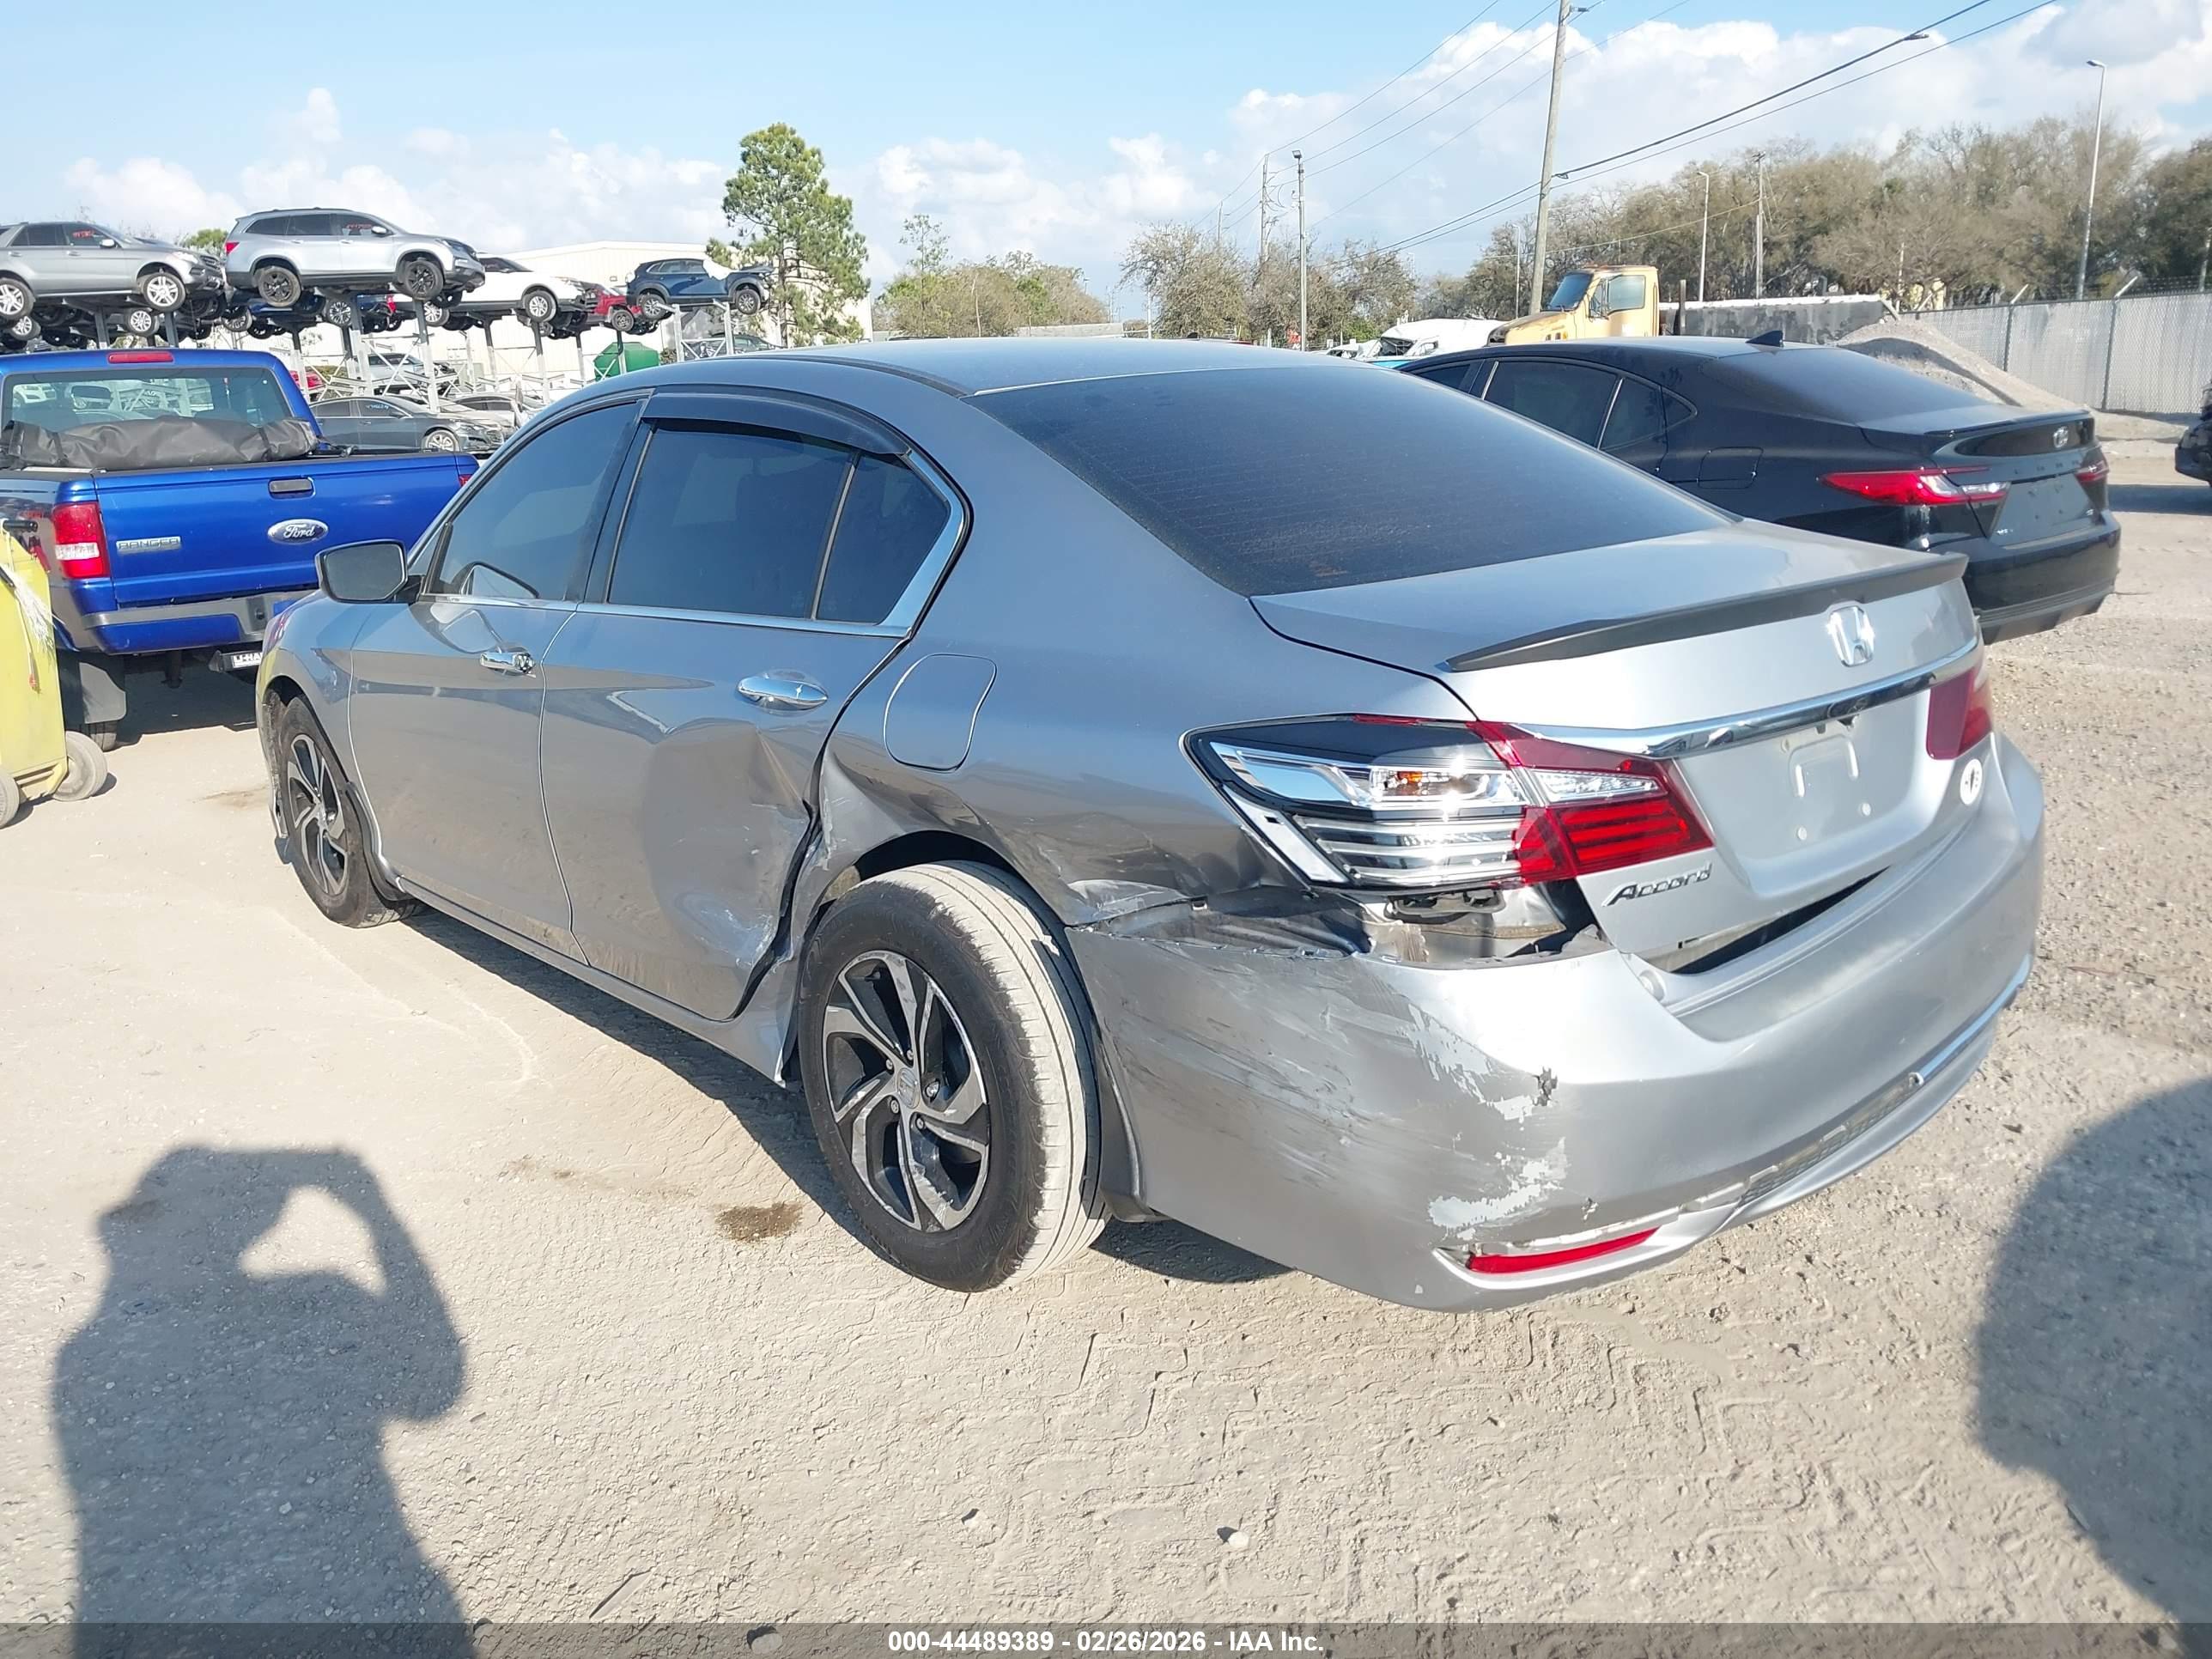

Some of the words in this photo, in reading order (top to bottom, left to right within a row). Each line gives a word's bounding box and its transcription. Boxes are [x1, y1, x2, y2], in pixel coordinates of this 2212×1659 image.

[283, 524, 316, 538] Ford
[118, 538, 179, 550] RANGER
[233, 652, 263, 662] U-HA
[1601, 860, 1713, 907] Accord
